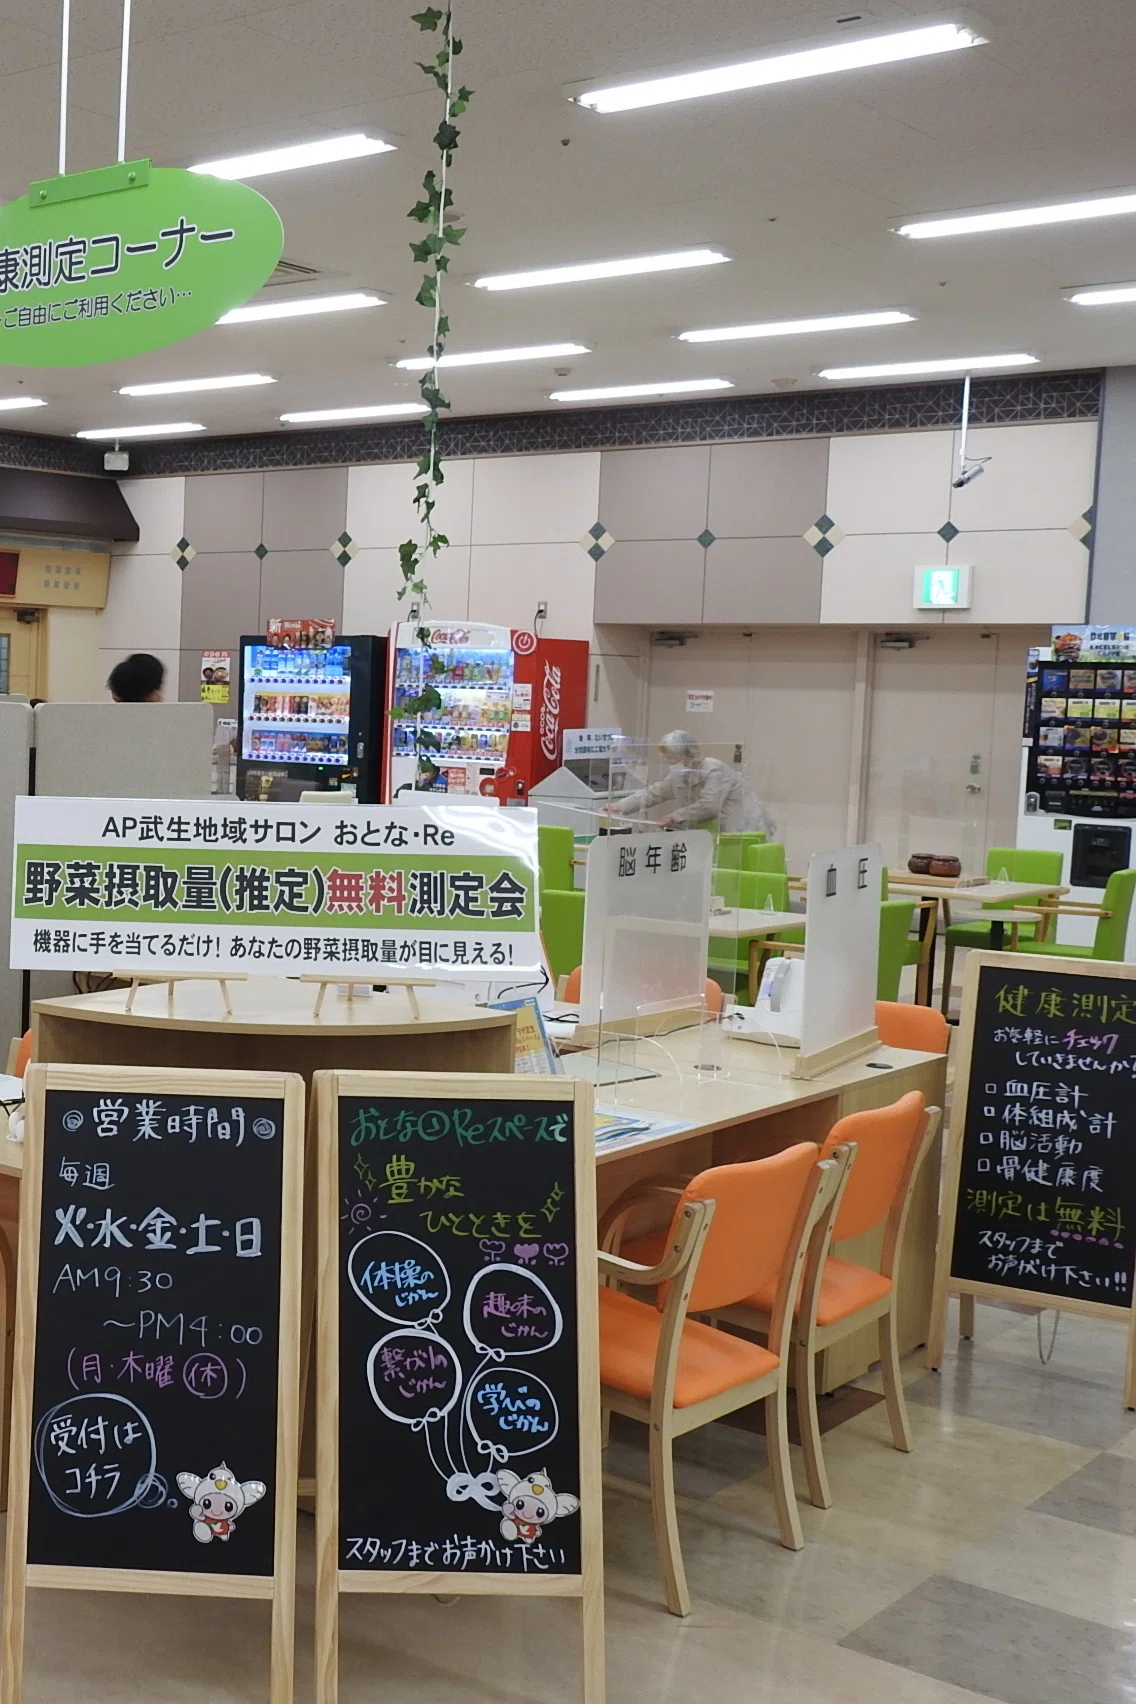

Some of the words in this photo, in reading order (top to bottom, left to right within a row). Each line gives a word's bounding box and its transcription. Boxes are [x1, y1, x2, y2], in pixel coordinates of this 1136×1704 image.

[540, 659, 562, 761] Coca-Cola
[101, 815, 321, 844] AP武生地域サロン
[333, 819, 455, 847] おとな・Re
[23, 859, 528, 921] 野菜摂取量(推定)無料測定会
[32, 928, 221, 958] 機器に手を当てるだけ!
[229, 935, 514, 966] あなたの野菜摂取量が目に見える!
[1003, 1079, 1089, 1109] 血圧計
[92, 1098, 246, 1147] 営業時間
[1001, 1102, 1118, 1140] 体組成計
[999, 1130, 1083, 1160] 脳活動
[58, 1156, 115, 1191] 毎週
[379, 1154, 465, 1204] 豊かな
[996, 1155, 1104, 1193] 骨健康度
[419, 1210, 542, 1238] ひとときを
[966, 1188, 1126, 1242] 測定は無料
[978, 1230, 1064, 1259] スタッフまで
[359, 1259, 435, 1294] 体操の
[482, 1291, 548, 1319] 趣味の
[476, 1382, 541, 1415] 学びの
[49, 1413, 143, 1456] 受付は
[64, 1462, 121, 1499] コチラ
